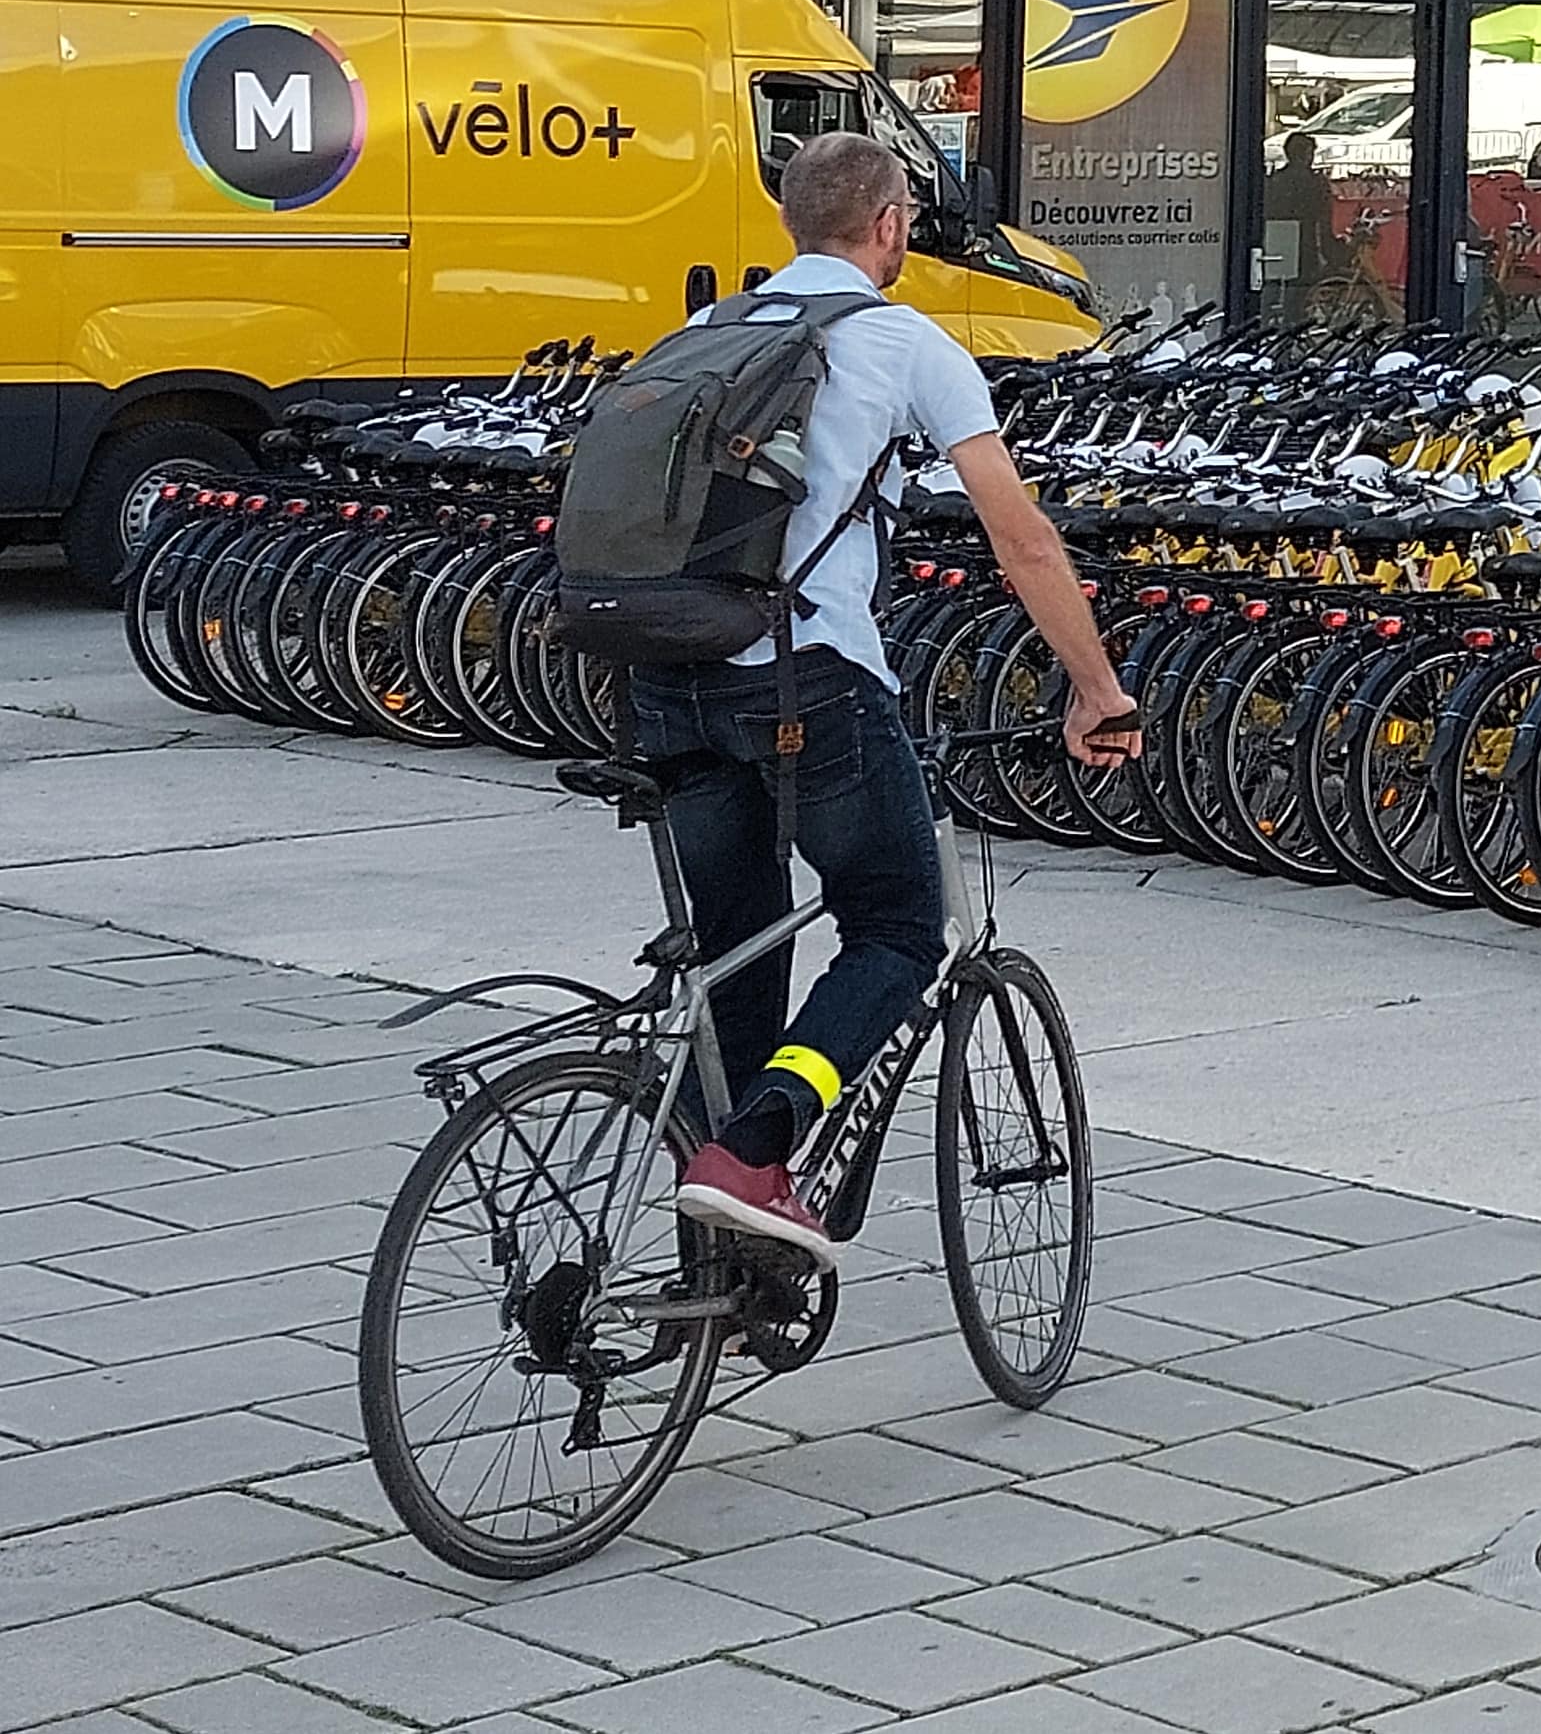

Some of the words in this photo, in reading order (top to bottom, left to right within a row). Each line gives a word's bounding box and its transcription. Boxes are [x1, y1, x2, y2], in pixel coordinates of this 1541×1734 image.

[233, 71, 313, 153] M
[1031, 142, 1219, 187] Entreprises
[1030, 198, 1159, 226] Découvrez
[1166, 198, 1193, 223] ici
[1058, 232, 1123, 246] solutions
[1128, 230, 1184, 245] courrier
[1188, 228, 1221, 244] colis
